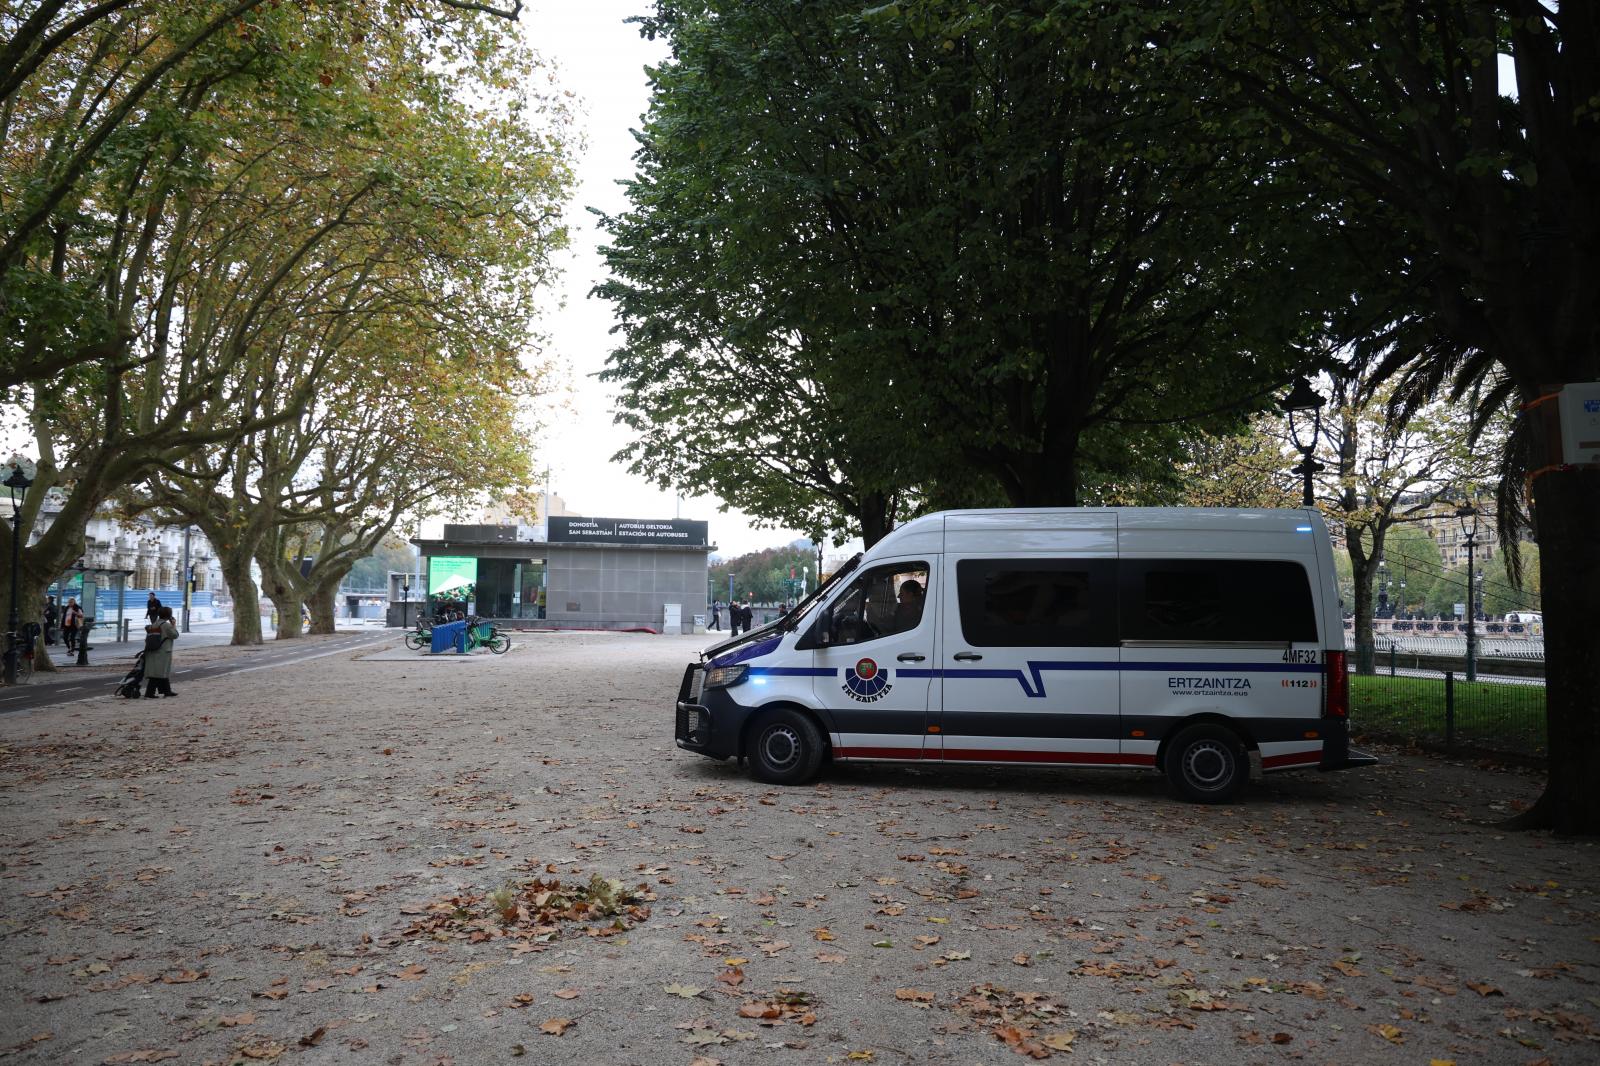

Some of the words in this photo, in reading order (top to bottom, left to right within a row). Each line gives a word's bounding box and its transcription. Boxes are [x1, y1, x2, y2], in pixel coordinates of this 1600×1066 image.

[618, 529, 647, 537] ESTACIÓN
[1282, 650, 1316, 663] 4MF32
[1168, 677, 1251, 689] ERTZAINTZA
[841, 684, 893, 703] ERTZAINTZA
[1172, 689, 1249, 697] www.ertzaintza.eus
